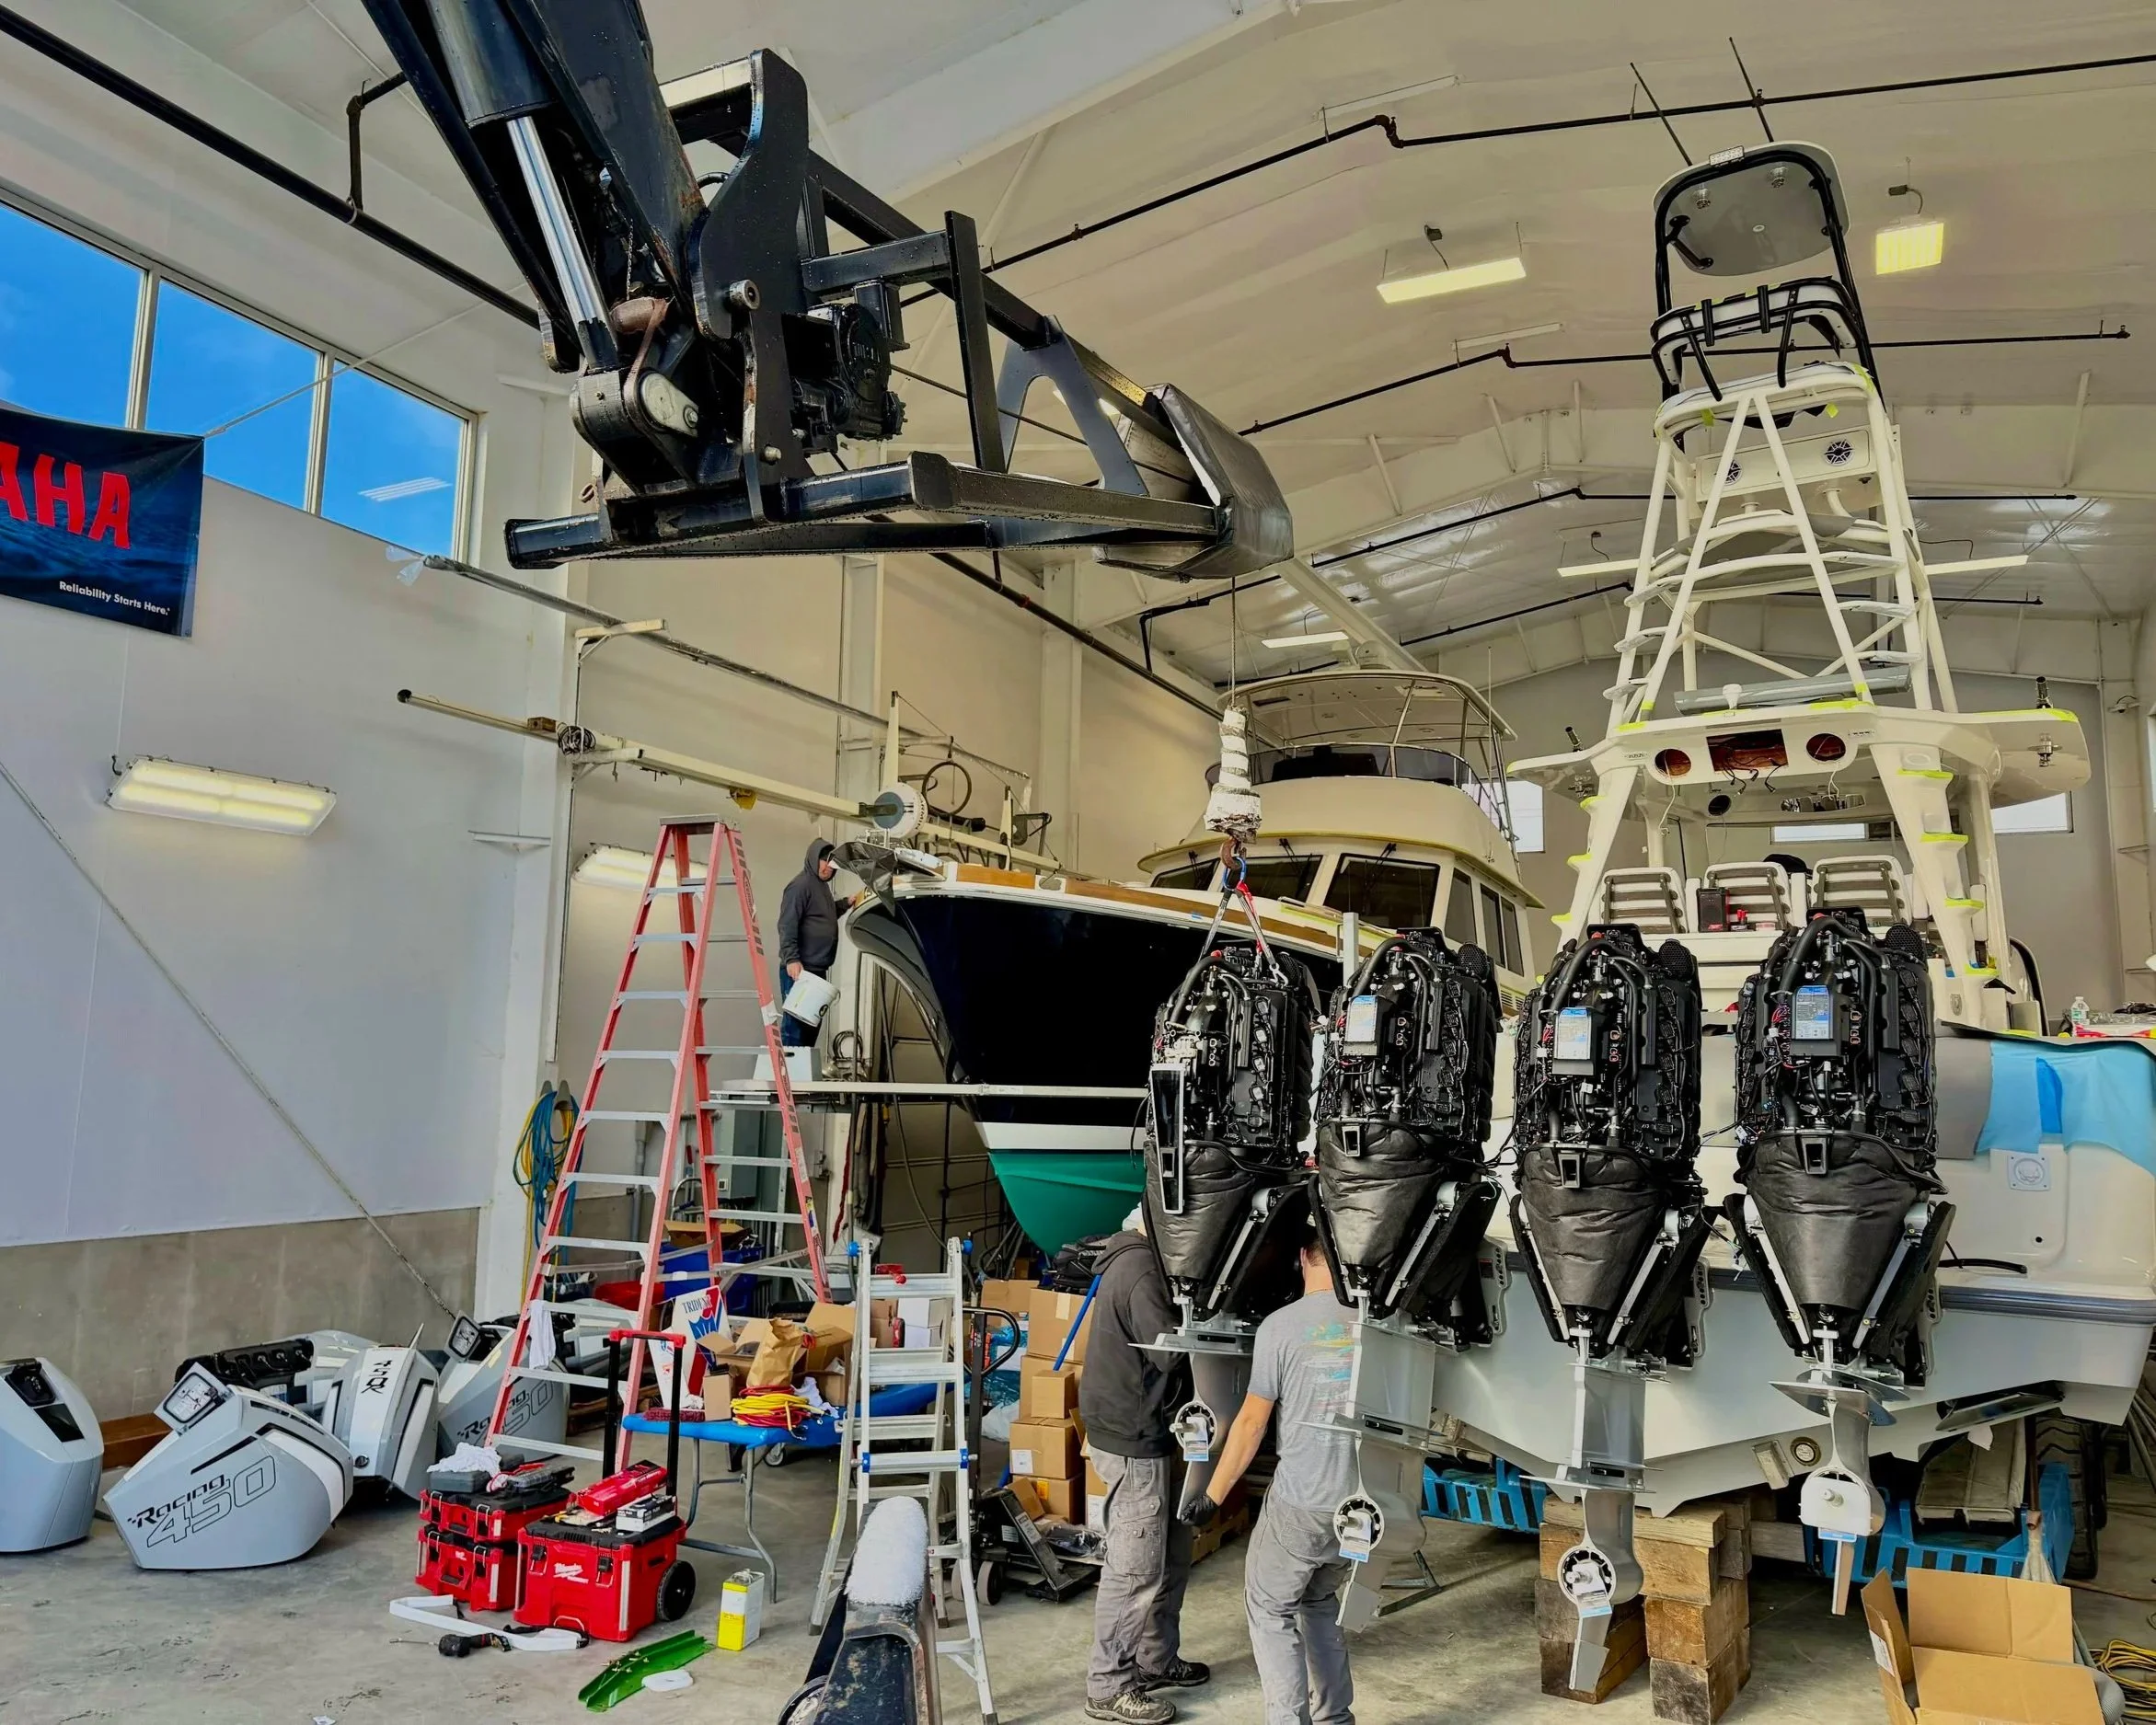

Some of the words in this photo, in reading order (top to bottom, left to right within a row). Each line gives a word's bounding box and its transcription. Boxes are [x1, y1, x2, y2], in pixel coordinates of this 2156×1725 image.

[59, 581, 111, 603] Reliability
[113, 593, 142, 608] Starts
[134, 1474, 226, 1528] Racing
[146, 1455, 276, 1548] 450
